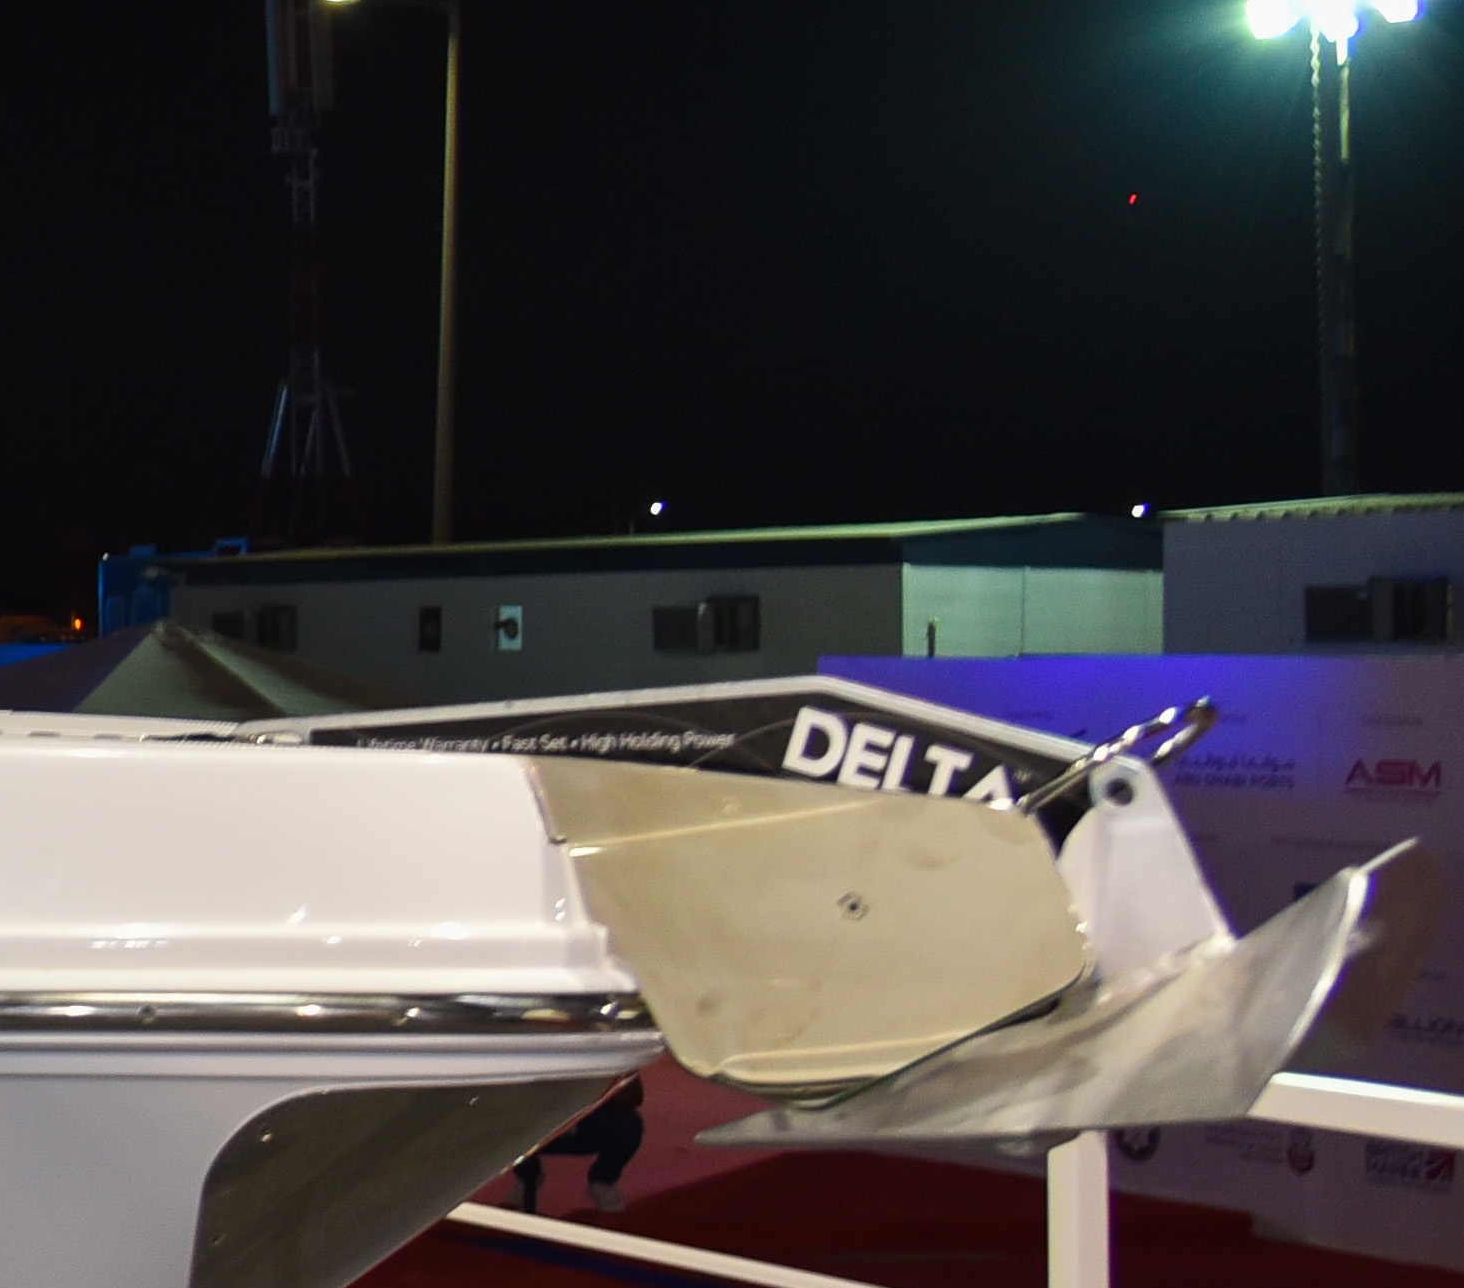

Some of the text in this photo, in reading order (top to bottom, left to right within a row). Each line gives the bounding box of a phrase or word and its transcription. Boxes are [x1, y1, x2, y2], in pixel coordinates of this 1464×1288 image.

[419, 735, 489, 753] Warranty
[502, 734, 537, 751] Fast
[540, 732, 568, 751] Set
[580, 731, 616, 754] High
[619, 729, 683, 754] Holding
[683, 730, 735, 749] Power
[781, 706, 1014, 806] DELTA
